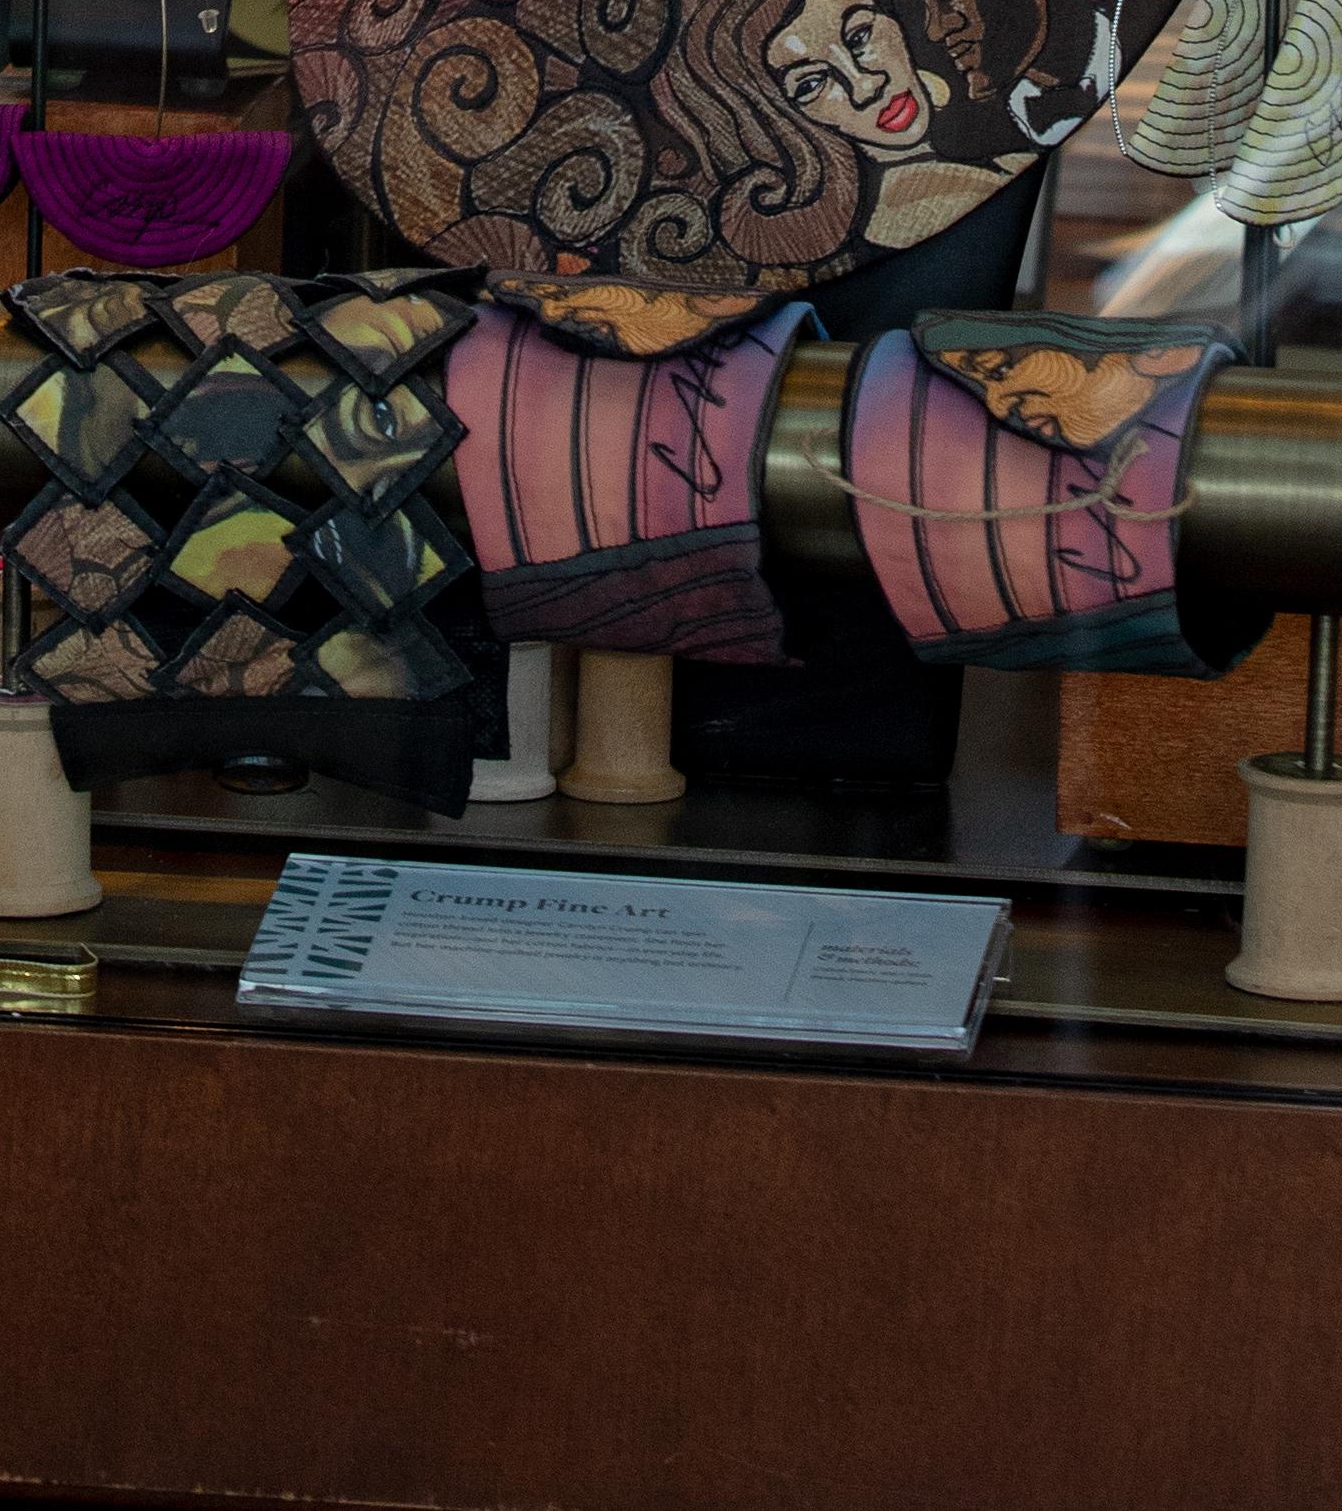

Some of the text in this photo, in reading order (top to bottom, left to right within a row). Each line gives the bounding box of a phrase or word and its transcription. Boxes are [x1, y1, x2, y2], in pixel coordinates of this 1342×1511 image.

[409, 888, 672, 919] Crump Fine Art
